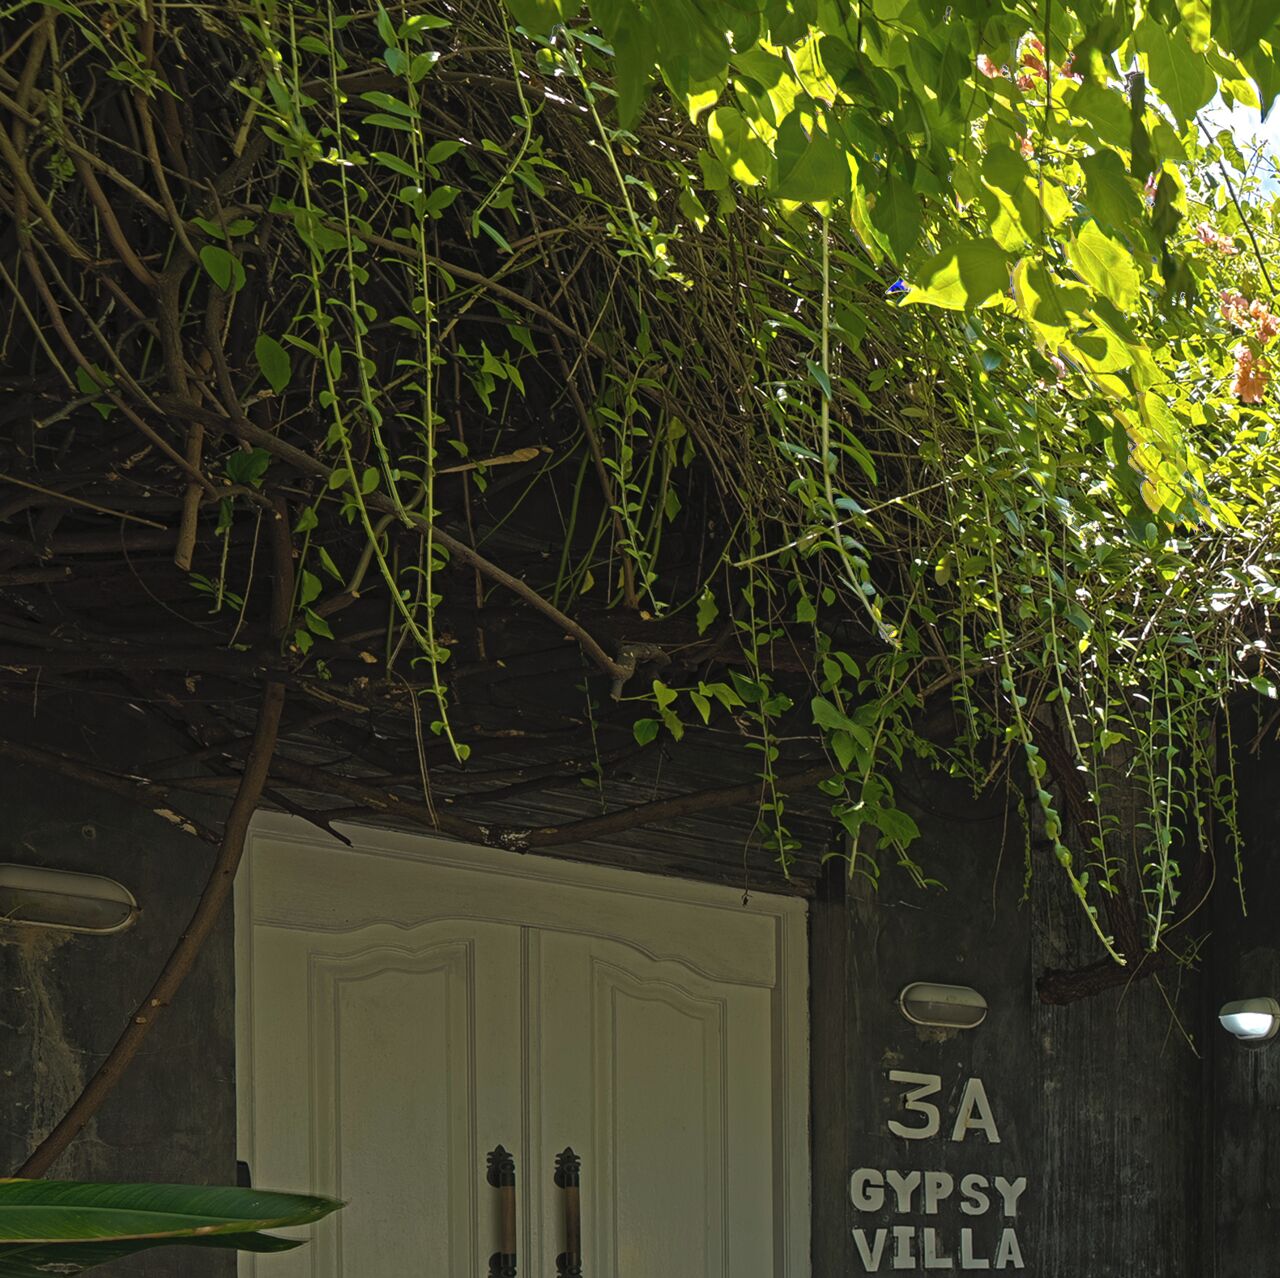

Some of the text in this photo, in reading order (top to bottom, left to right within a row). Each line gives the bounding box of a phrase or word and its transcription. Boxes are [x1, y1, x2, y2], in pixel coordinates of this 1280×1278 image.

[887, 1069, 1001, 1143] 3A
[850, 1167, 1028, 1217] GYPSY
[851, 1225, 1026, 1273] VILLA
